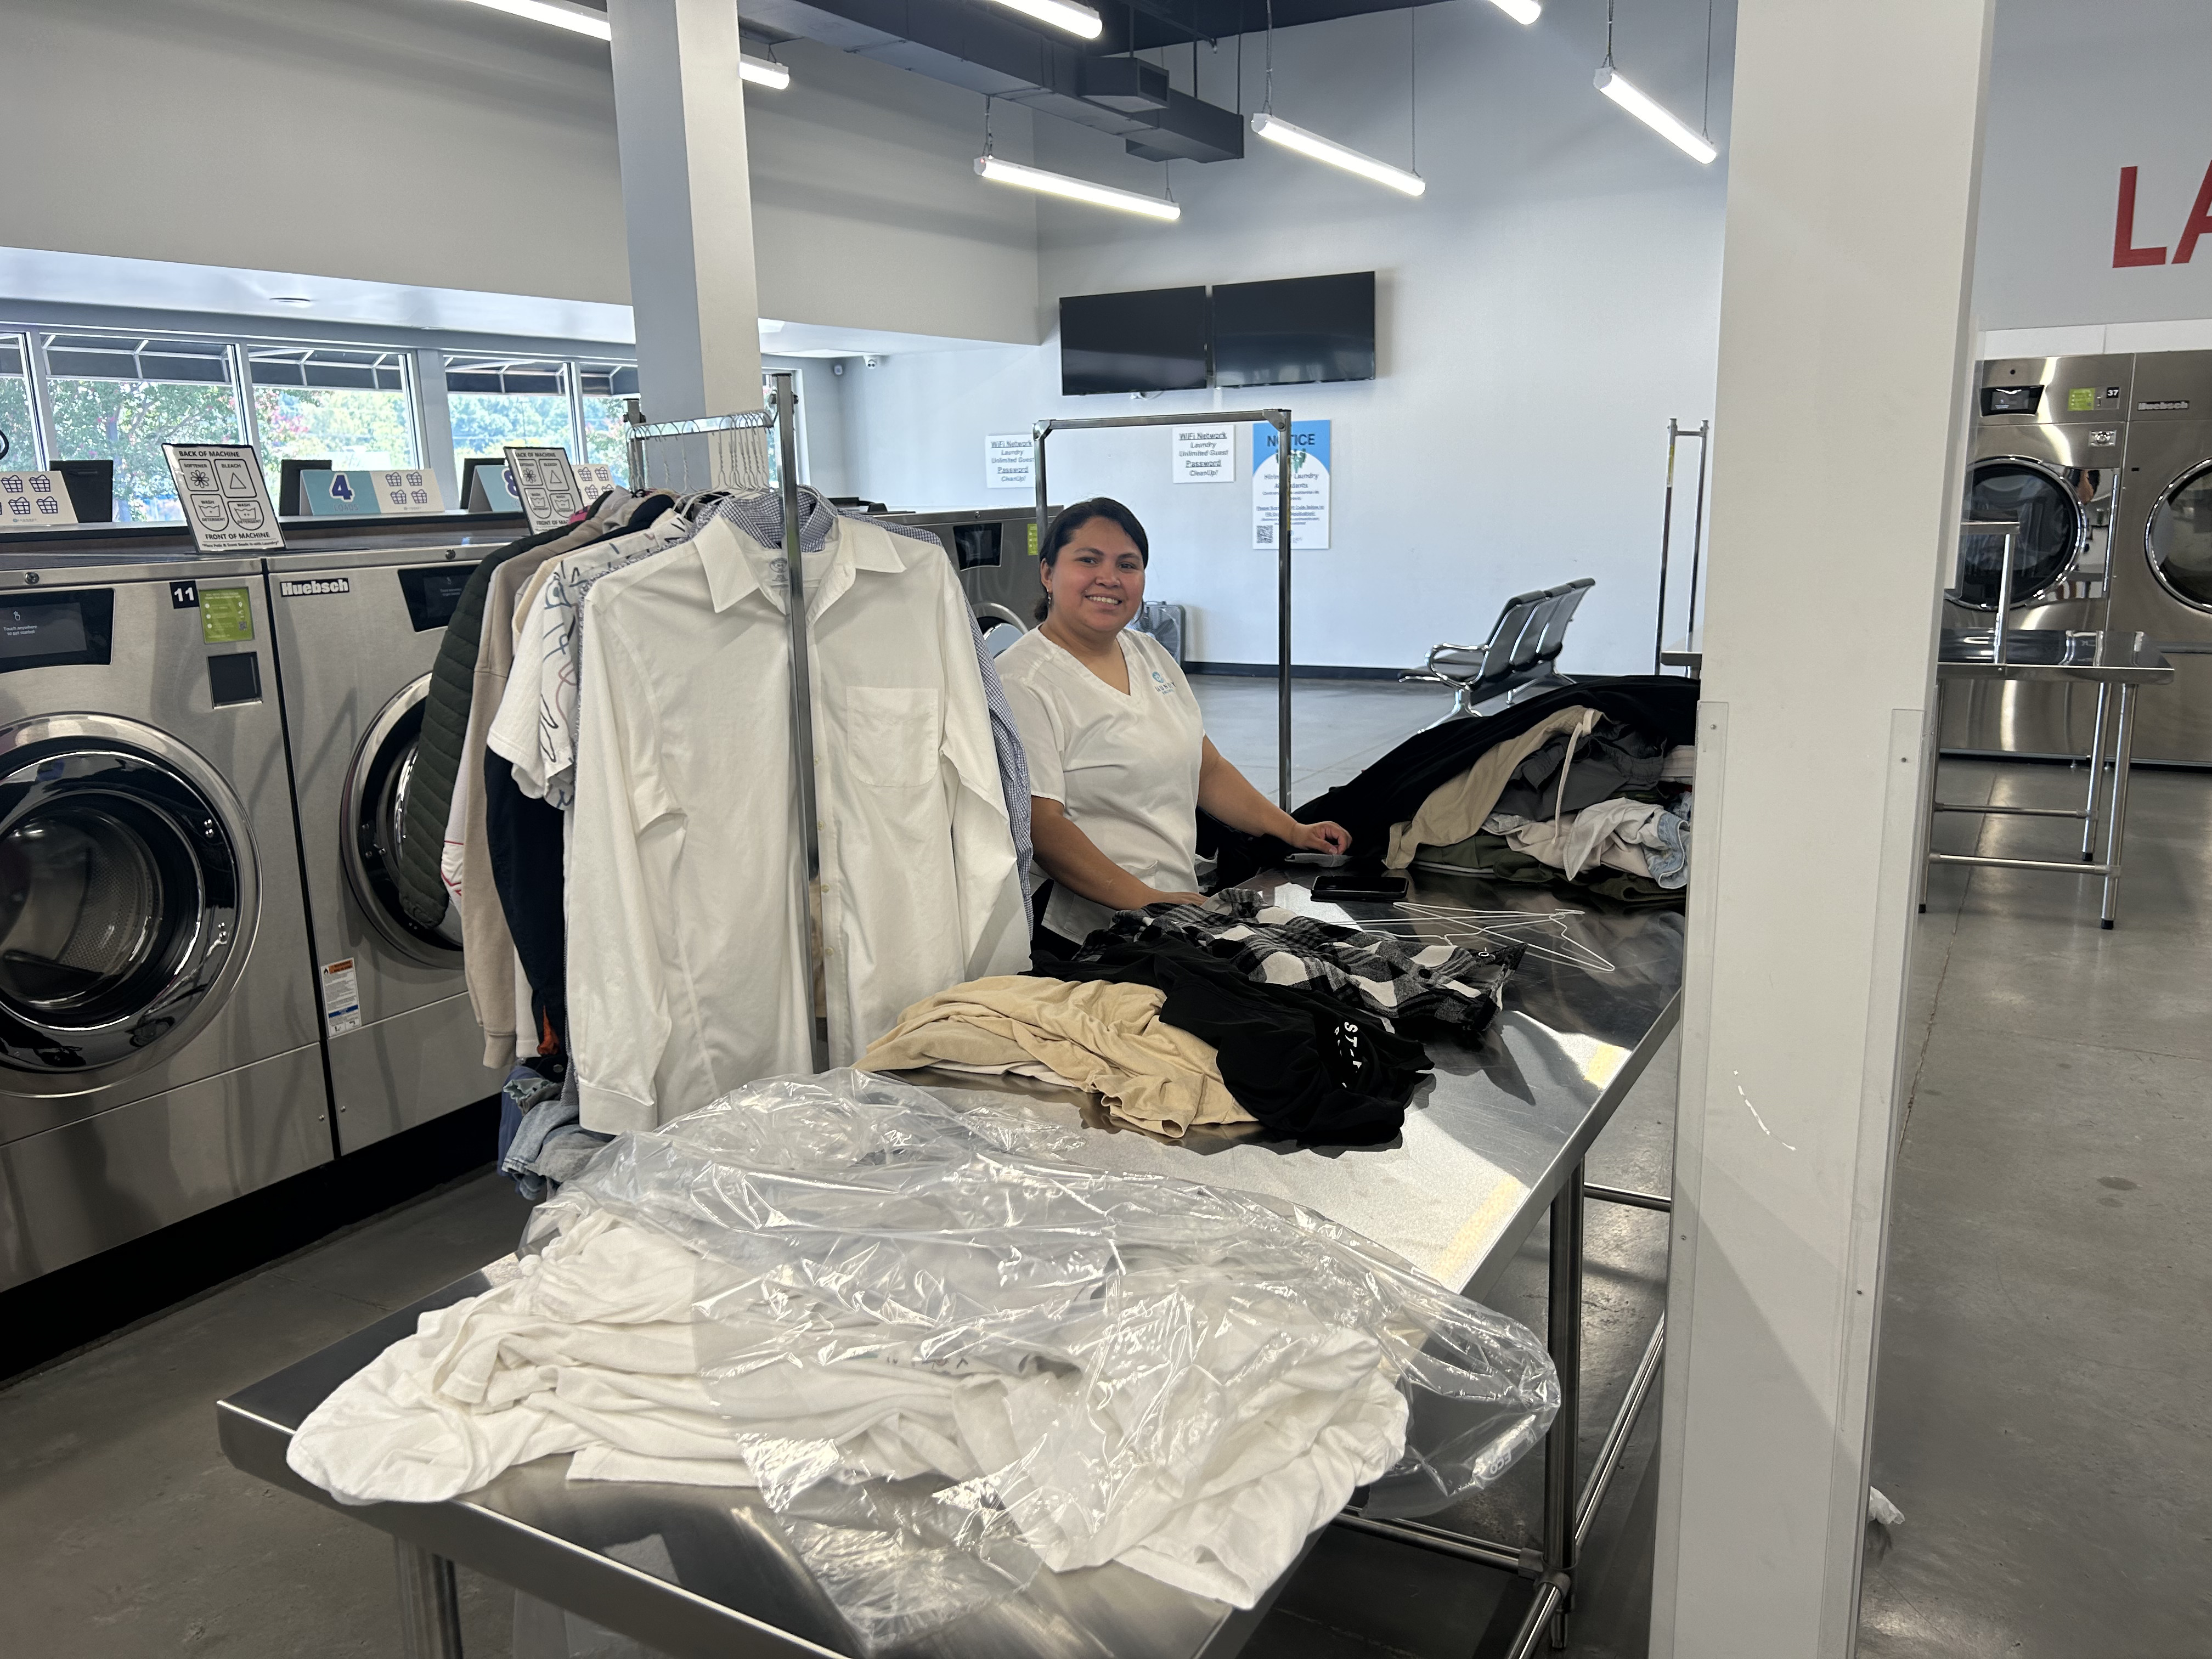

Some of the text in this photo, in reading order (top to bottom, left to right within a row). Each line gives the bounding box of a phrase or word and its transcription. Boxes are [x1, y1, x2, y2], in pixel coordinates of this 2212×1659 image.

[2138, 401, 2188, 410] Huebsch
[1267, 434, 1315, 447] NICE
[331, 473, 354, 501] 4
[334, 503, 359, 511] LOADS
[281, 579, 348, 595] Huebsch
[174, 587, 194, 602] 11
